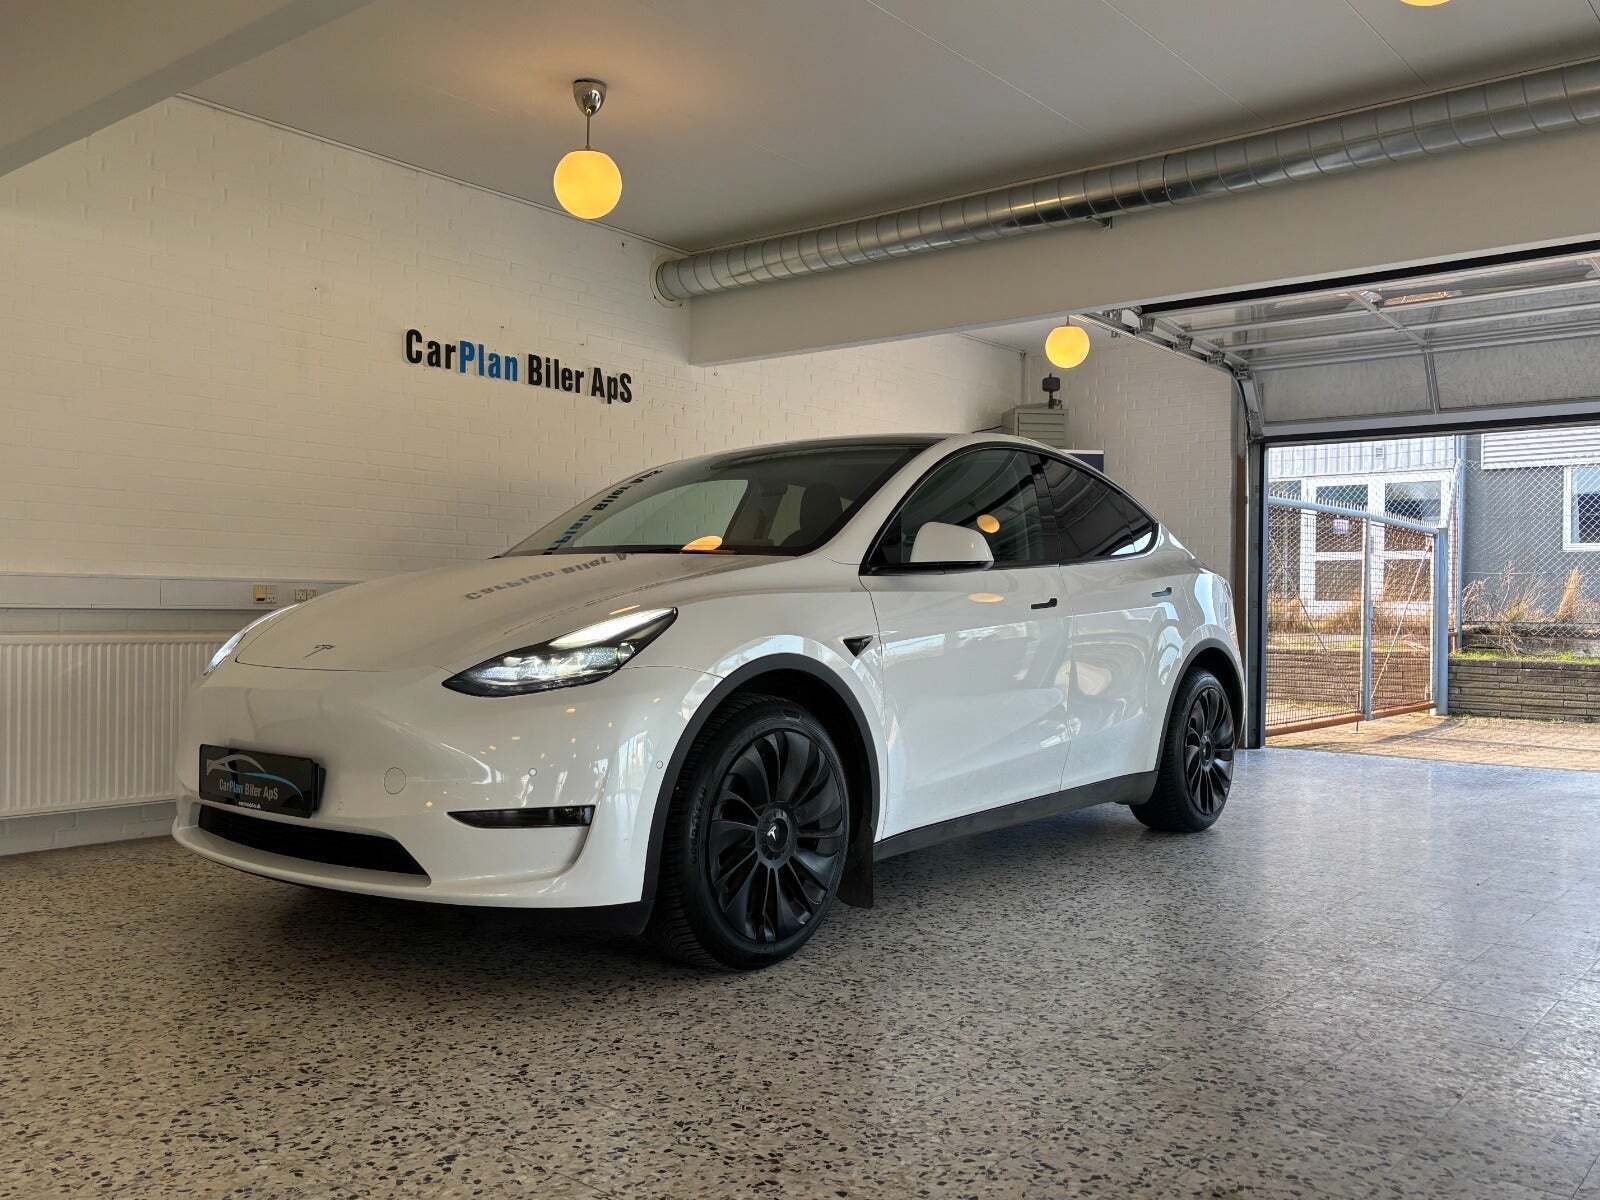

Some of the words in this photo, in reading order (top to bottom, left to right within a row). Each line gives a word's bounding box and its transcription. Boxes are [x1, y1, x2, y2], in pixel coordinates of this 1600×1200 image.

[405, 328, 519, 382] CarPlan
[527, 353, 585, 394] Biler
[590, 367, 633, 405] ApS
[244, 783, 262, 798] Biler
[262, 785, 279, 801] ApS
